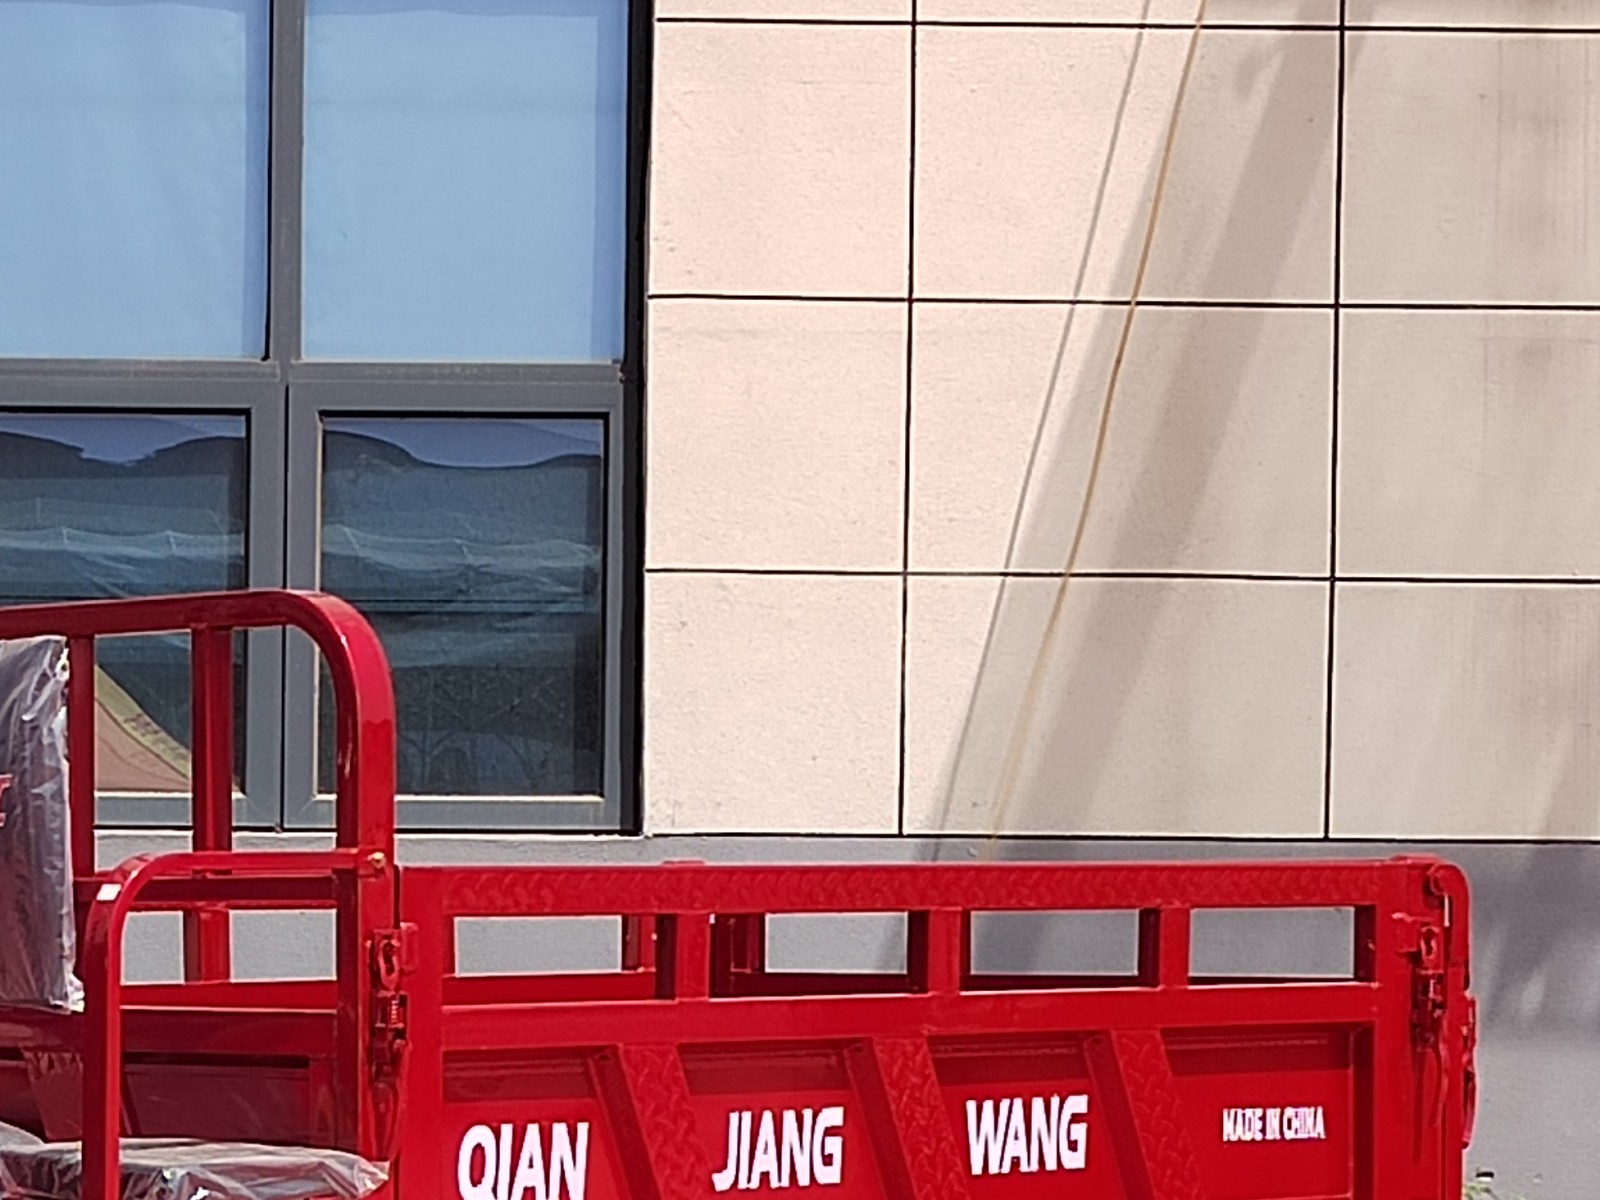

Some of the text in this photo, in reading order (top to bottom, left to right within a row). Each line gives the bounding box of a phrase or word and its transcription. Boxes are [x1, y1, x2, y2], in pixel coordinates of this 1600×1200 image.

[711, 1106, 844, 1192] JIANG
[966, 1094, 1089, 1176] WANG
[1222, 1105, 1326, 1142] MADE IN CHINA
